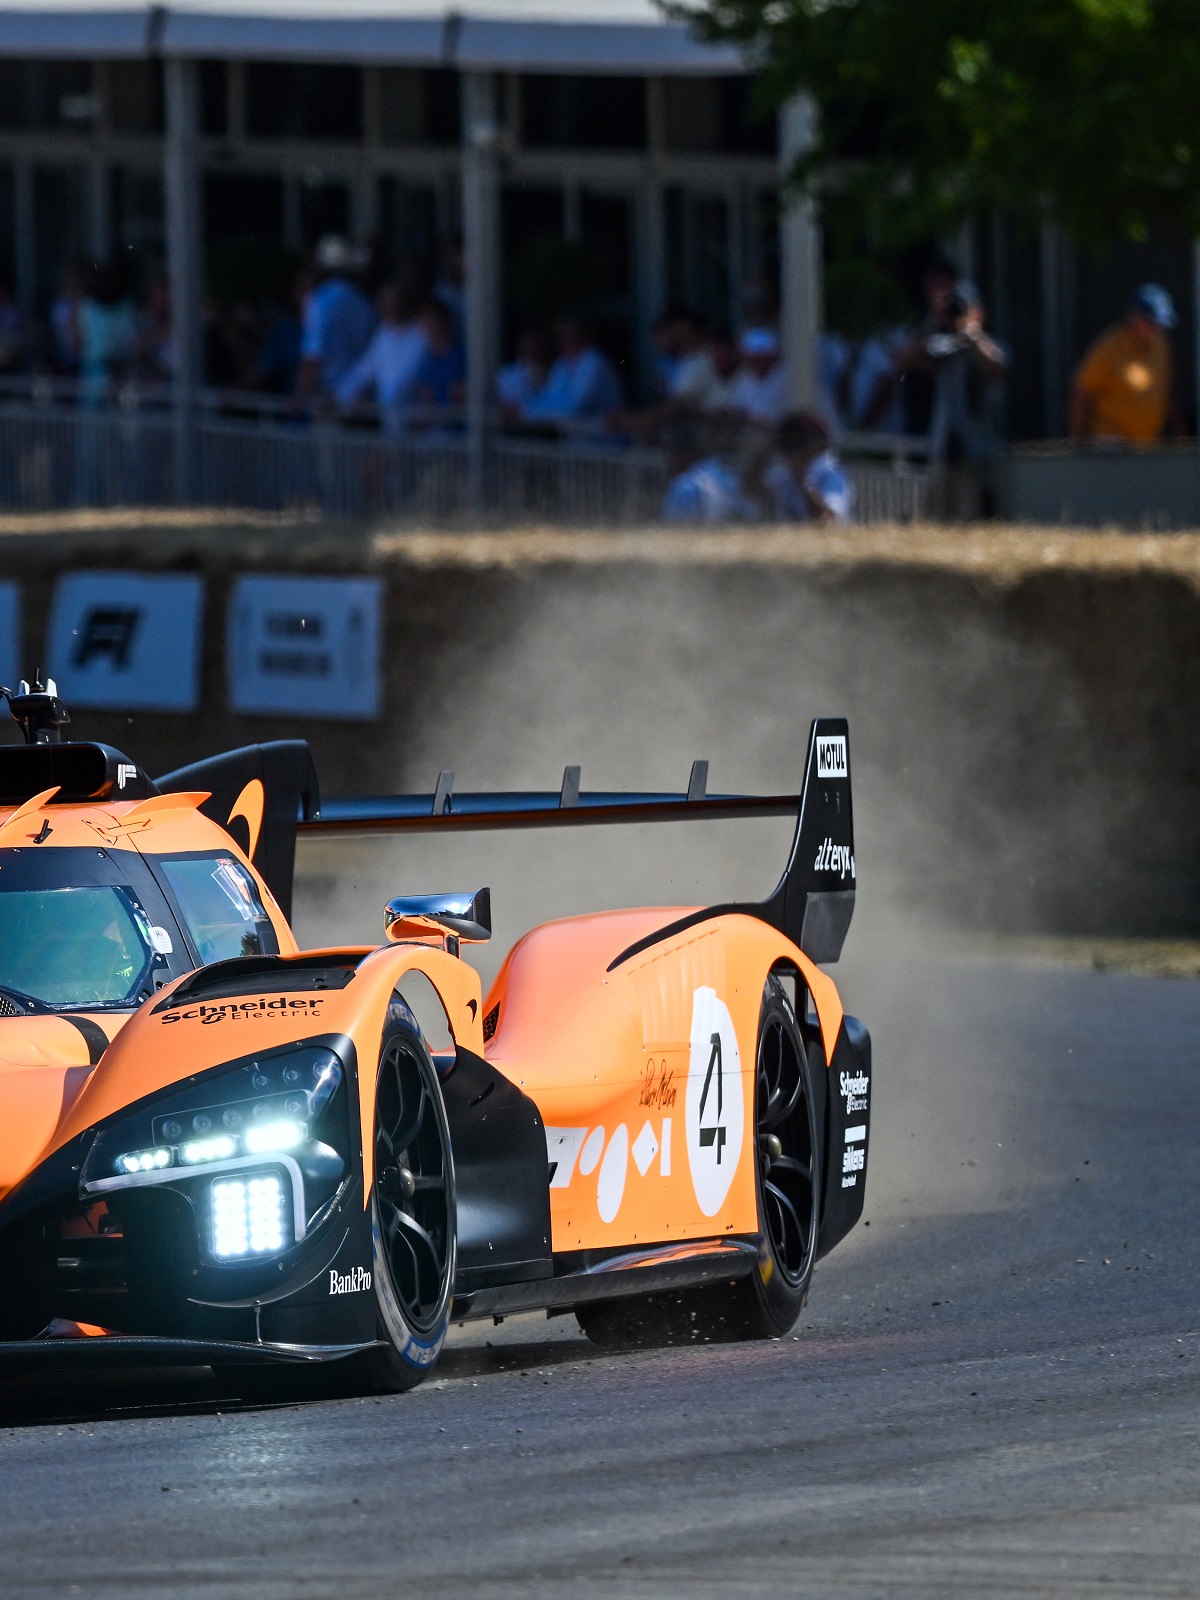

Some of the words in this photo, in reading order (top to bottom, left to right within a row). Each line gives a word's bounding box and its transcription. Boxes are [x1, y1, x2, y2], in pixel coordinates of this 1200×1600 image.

[819, 743, 845, 770] MOTUL
[814, 837, 851, 880] alteryx
[161, 997, 324, 1025] Schneider
[232, 1008, 321, 1020] Electric
[840, 1070, 869, 1096] Schneider
[699, 1032, 727, 1165] 4
[328, 1266, 372, 1295] BankPro
